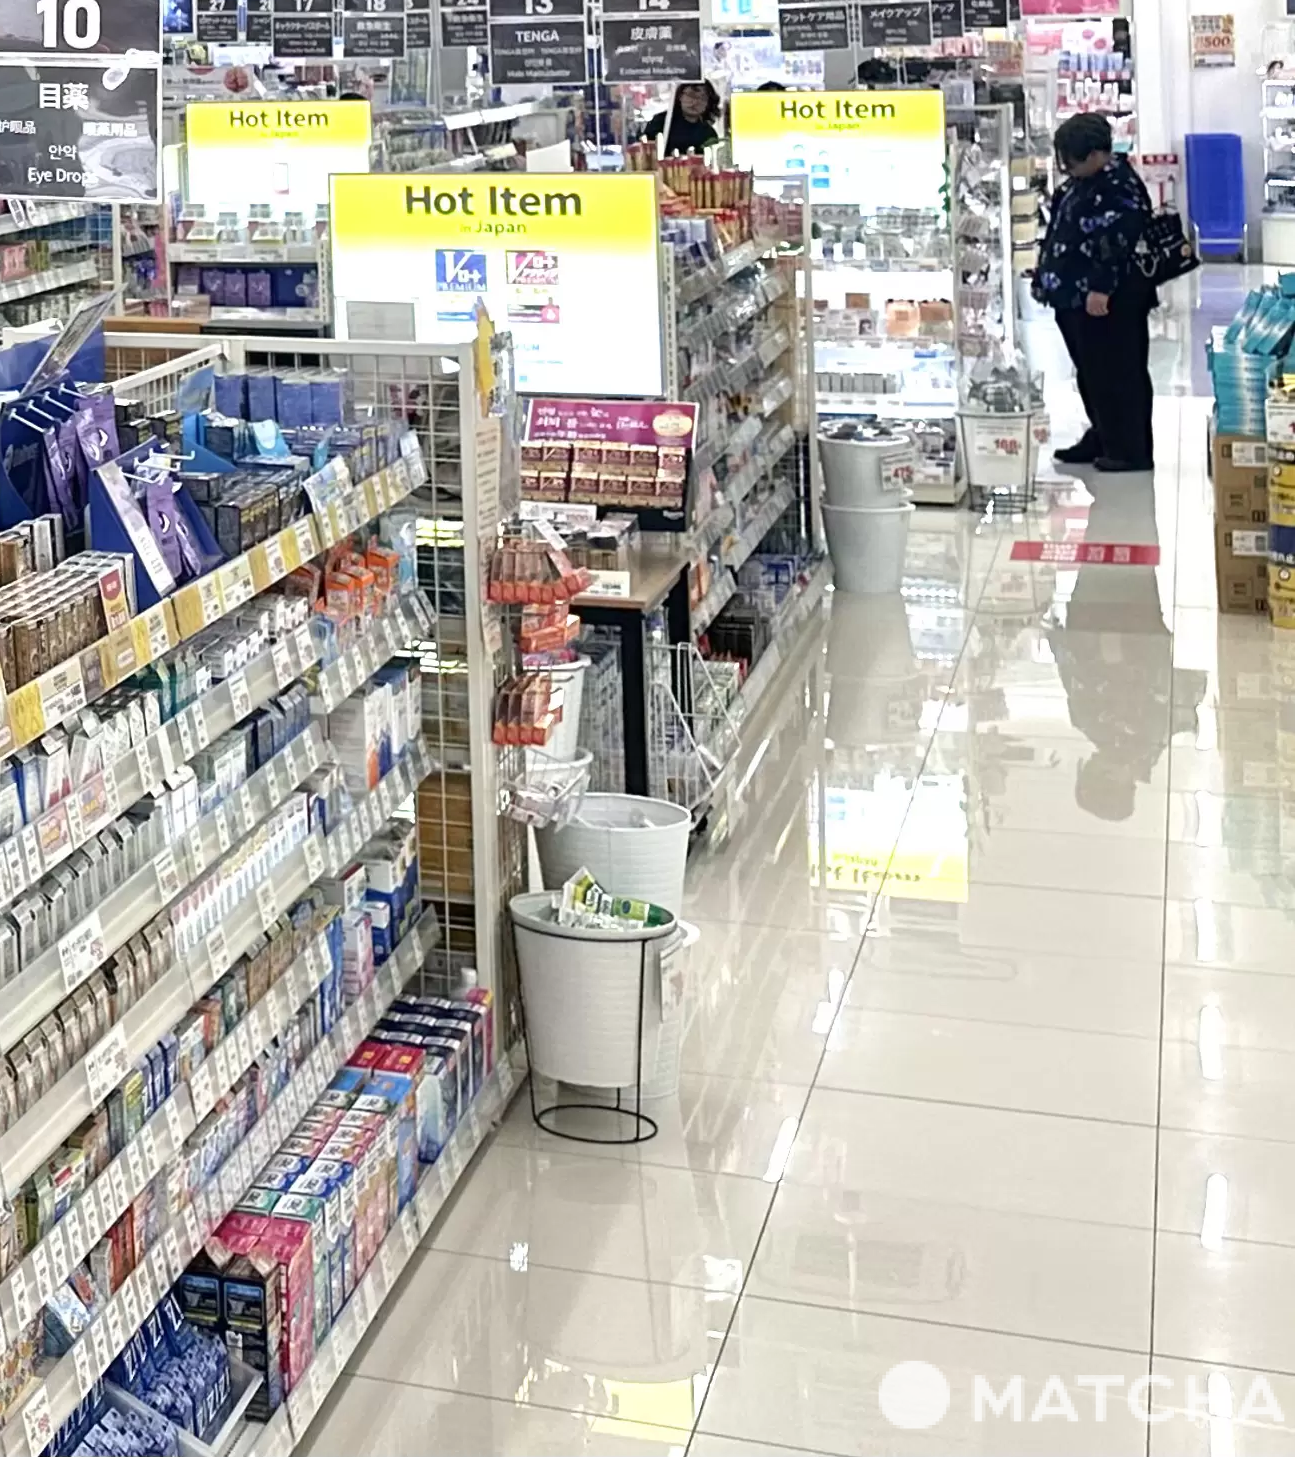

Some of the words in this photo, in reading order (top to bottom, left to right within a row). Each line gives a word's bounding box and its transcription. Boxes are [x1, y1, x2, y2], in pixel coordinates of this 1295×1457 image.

[514, 30, 560, 44] TENGA
[38, 82, 91, 112] 目薬
[780, 98, 826, 121] Hot
[835, 98, 897, 119] Item
[228, 110, 269, 129] Hot
[277, 110, 329, 128] Item
[27, 168, 58, 187] Eye
[59, 168, 99, 186] Drops
[404, 184, 476, 217] Hot
[488, 184, 583, 217] Item
[474, 219, 528, 237] Japan
